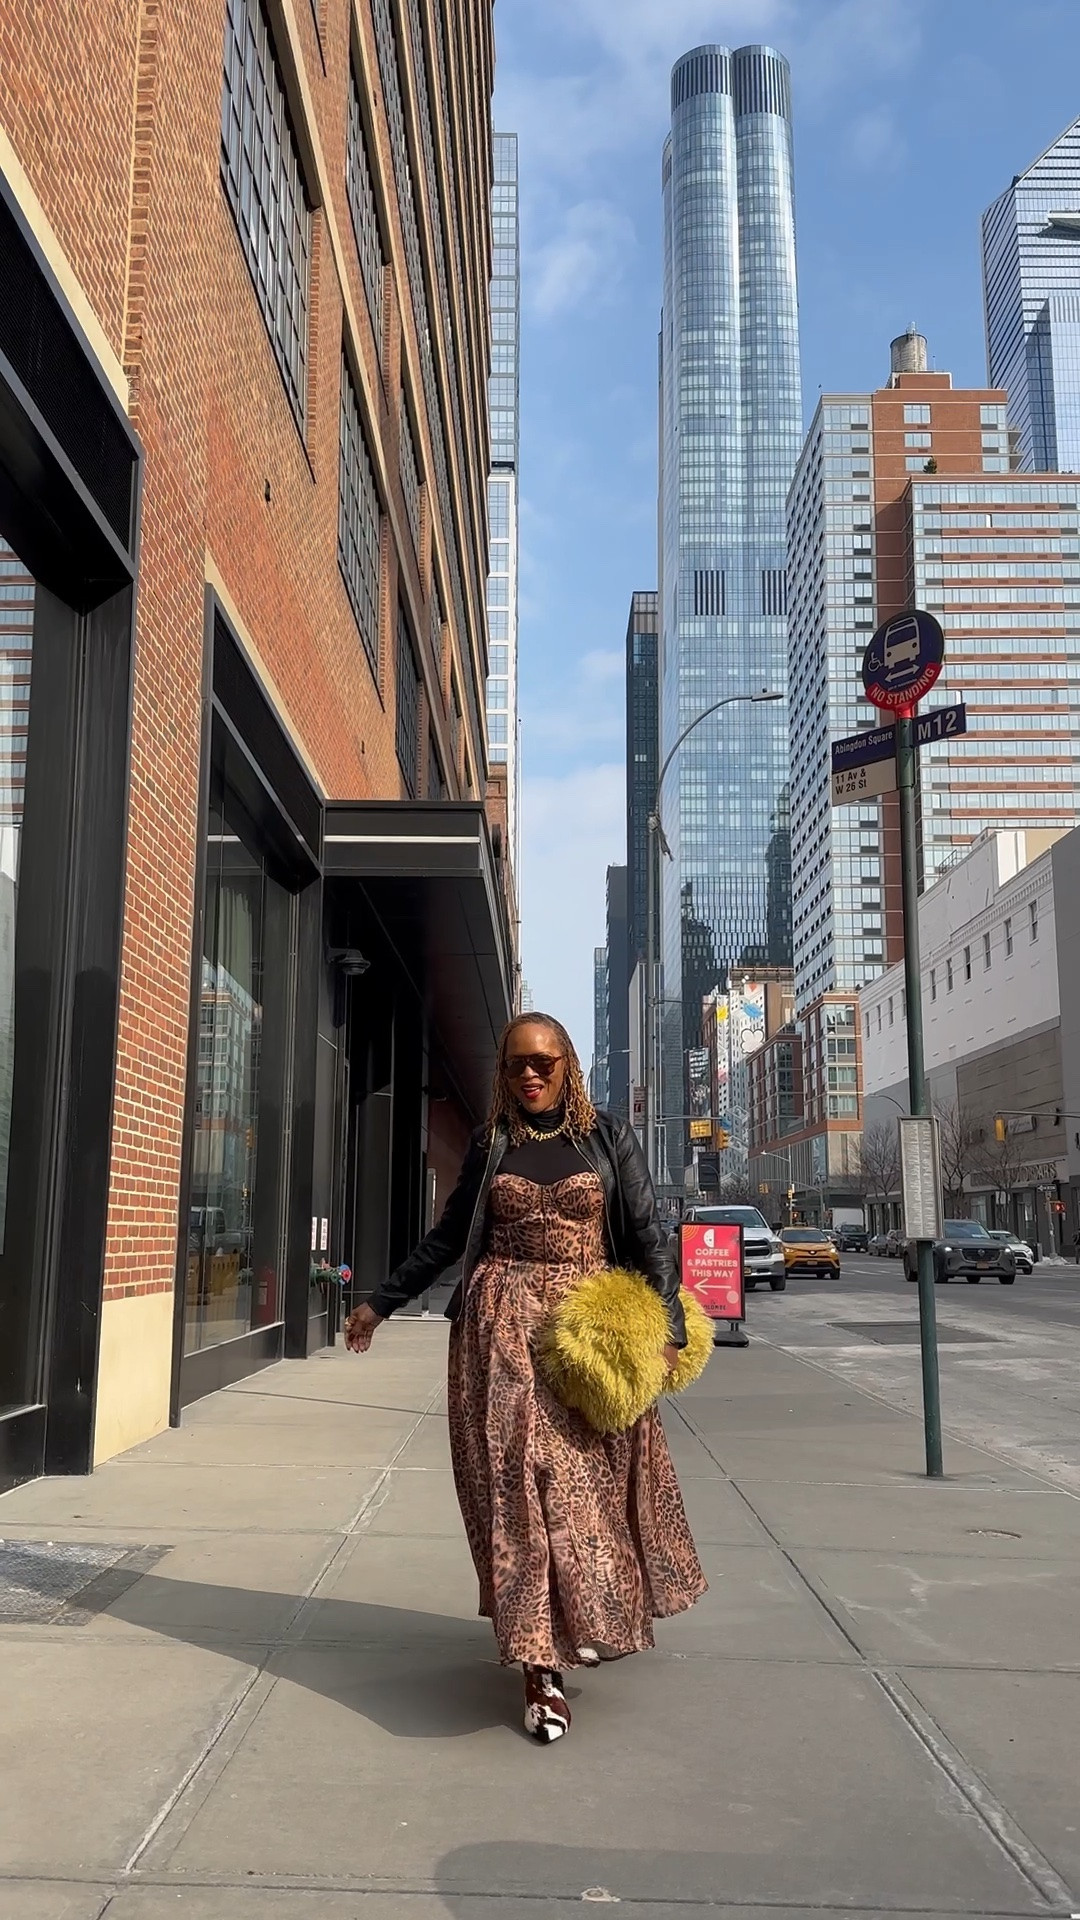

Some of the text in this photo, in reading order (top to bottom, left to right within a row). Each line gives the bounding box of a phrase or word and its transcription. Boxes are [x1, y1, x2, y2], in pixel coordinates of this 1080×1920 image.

[871, 686, 885, 702] NO
[886, 668, 936, 704] STANDING
[917, 710, 957, 740] M12
[835, 731, 893, 755] Abingdon Square
[836, 768, 866, 784] 11 Av &
[835, 779, 866, 795] W 26 St
[695, 1248, 729, 1256] COFFEE
[695, 1259, 738, 1267] PASTRIES
[691, 1269, 712, 1277] THIS
